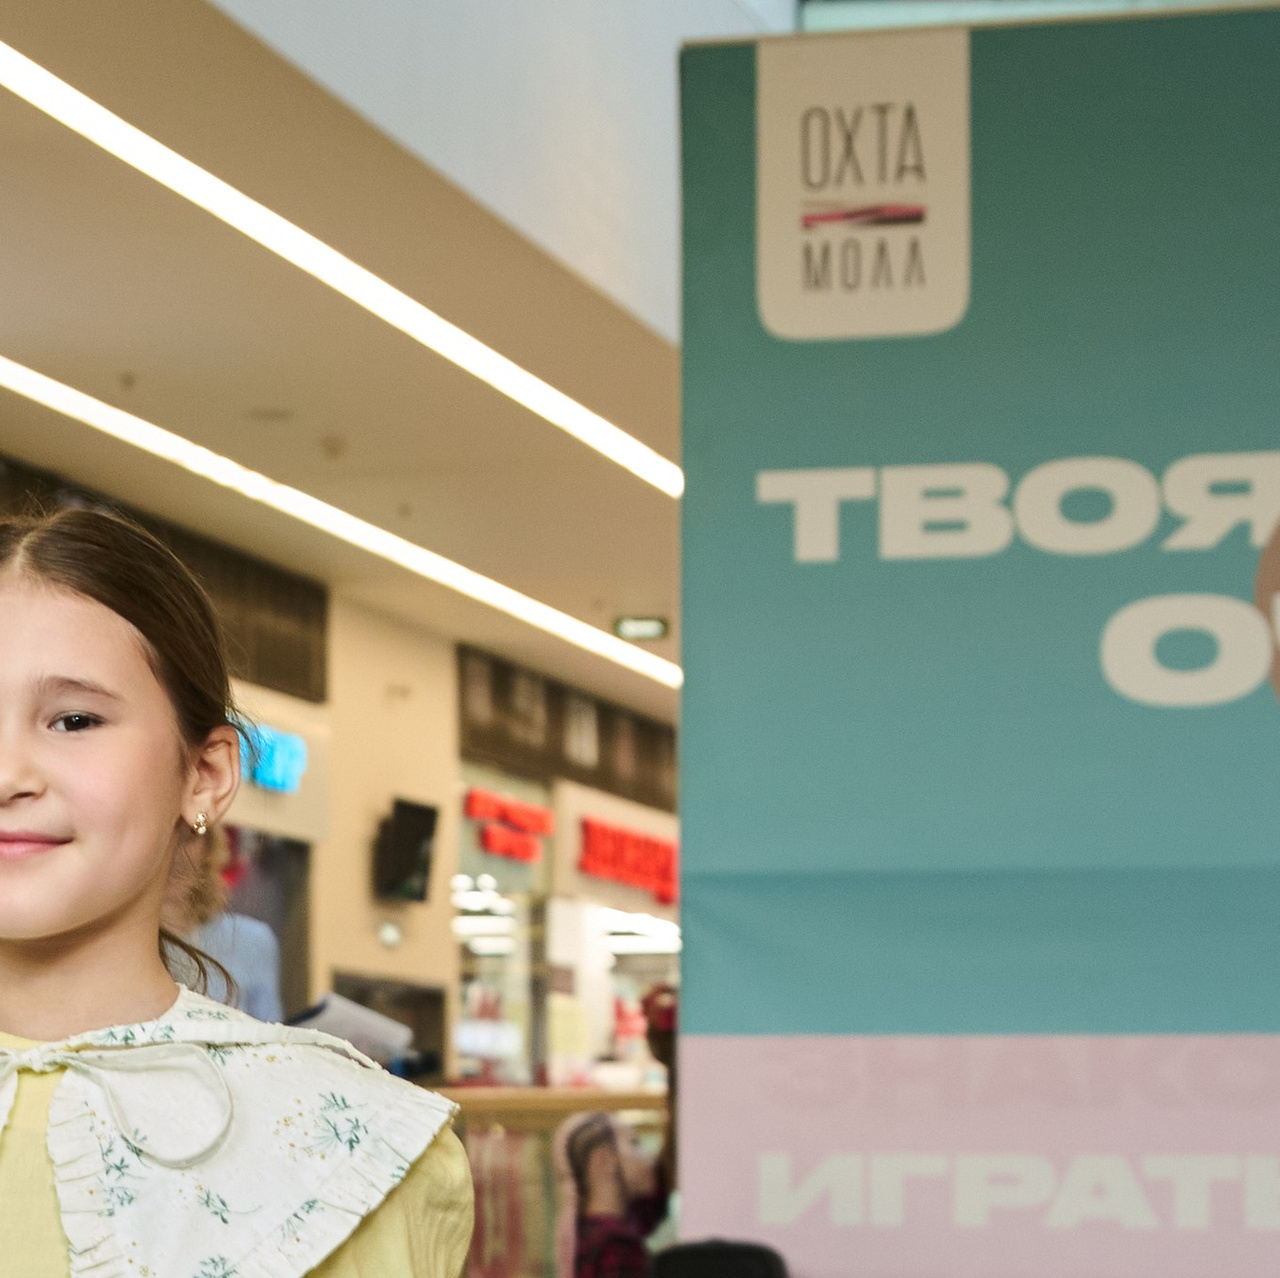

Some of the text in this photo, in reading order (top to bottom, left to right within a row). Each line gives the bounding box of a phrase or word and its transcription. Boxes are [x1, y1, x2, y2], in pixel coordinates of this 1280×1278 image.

[800, 102, 927, 191] ОХТА
[802, 237, 927, 292] МОЛЛ
[756, 450, 1280, 563] ТВОЯ
